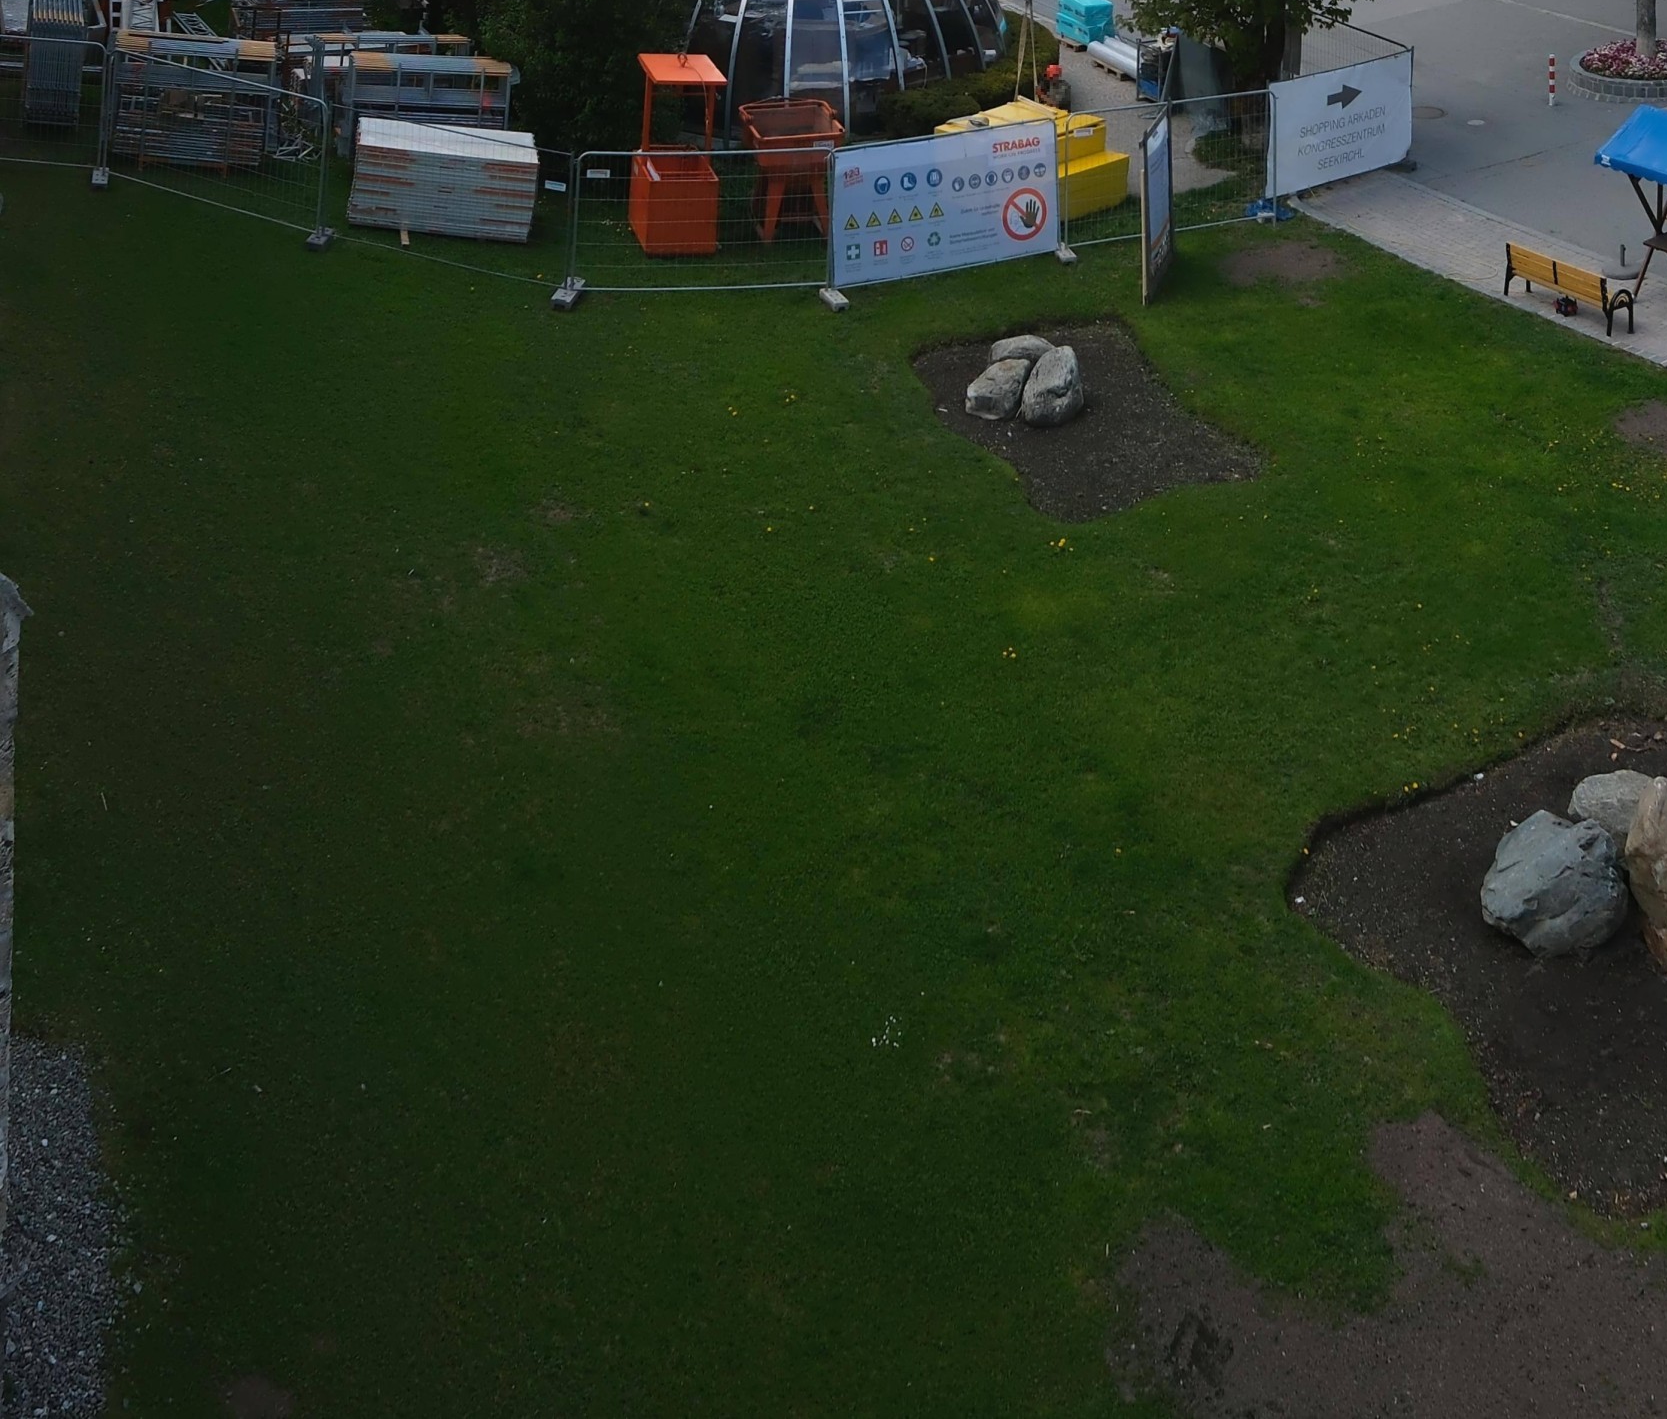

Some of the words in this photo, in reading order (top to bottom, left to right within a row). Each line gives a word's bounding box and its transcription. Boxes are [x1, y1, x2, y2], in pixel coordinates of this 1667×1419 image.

[1299, 116, 1346, 139] SHOPPING
[1348, 105, 1386, 126] ARKADEN
[992, 136, 1040, 154] STRABAG
[1297, 124, 1386, 157] KONGRESSZENTRUM
[1317, 148, 1365, 171] SEEKIRCHL
